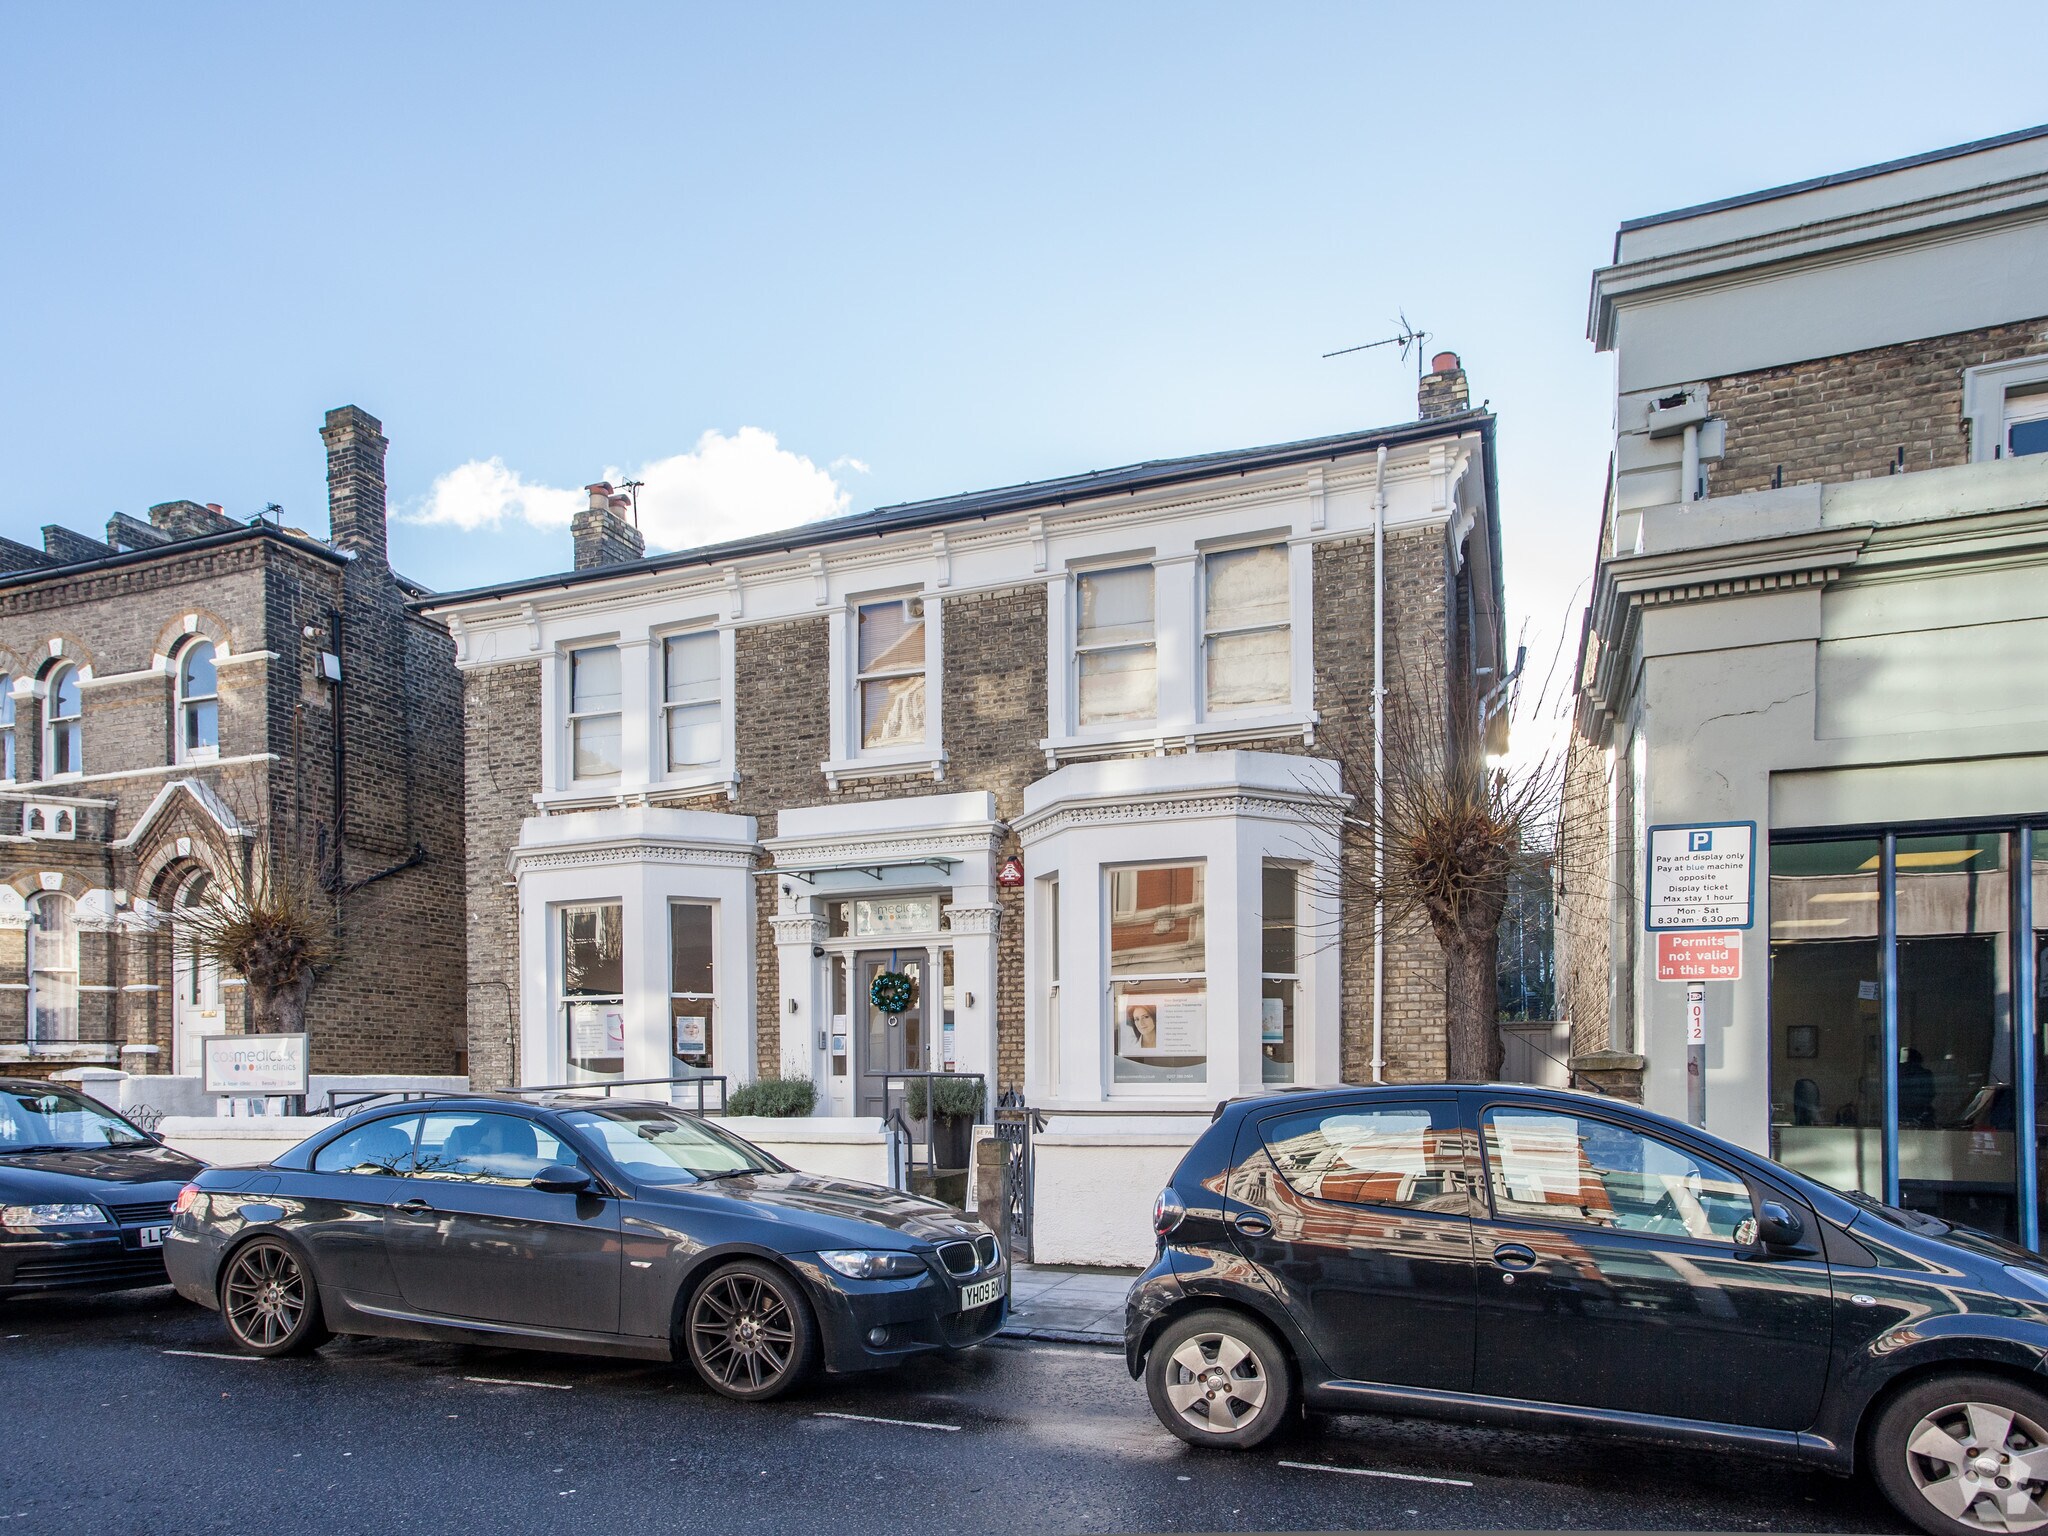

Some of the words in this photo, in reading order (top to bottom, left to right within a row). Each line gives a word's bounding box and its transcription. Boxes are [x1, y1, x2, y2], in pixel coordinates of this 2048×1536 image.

[1694, 833, 1709, 850] P
[1656, 855, 1671, 863] Pay
[1693, 853, 1723, 862] display
[1726, 852, 1745, 860] only
[1657, 865, 1672, 873] Pay
[1707, 862, 1743, 870] machine
[1678, 874, 1716, 882] opposite
[1684, 895, 1702, 903] stay
[1701, 915, 1723, 923] 6.30
[1673, 936, 1725, 947] Permits
[1669, 951, 1691, 961] not
[1696, 949, 1729, 960] valid
[1662, 965, 1674, 975] in
[1680, 964, 1705, 975] this
[1711, 964, 1735, 975] bay
[212, 1049, 295, 1062] cosmedicsK
[272, 1063, 296, 1071] clinics
[967, 1283, 989, 1306] YH09
